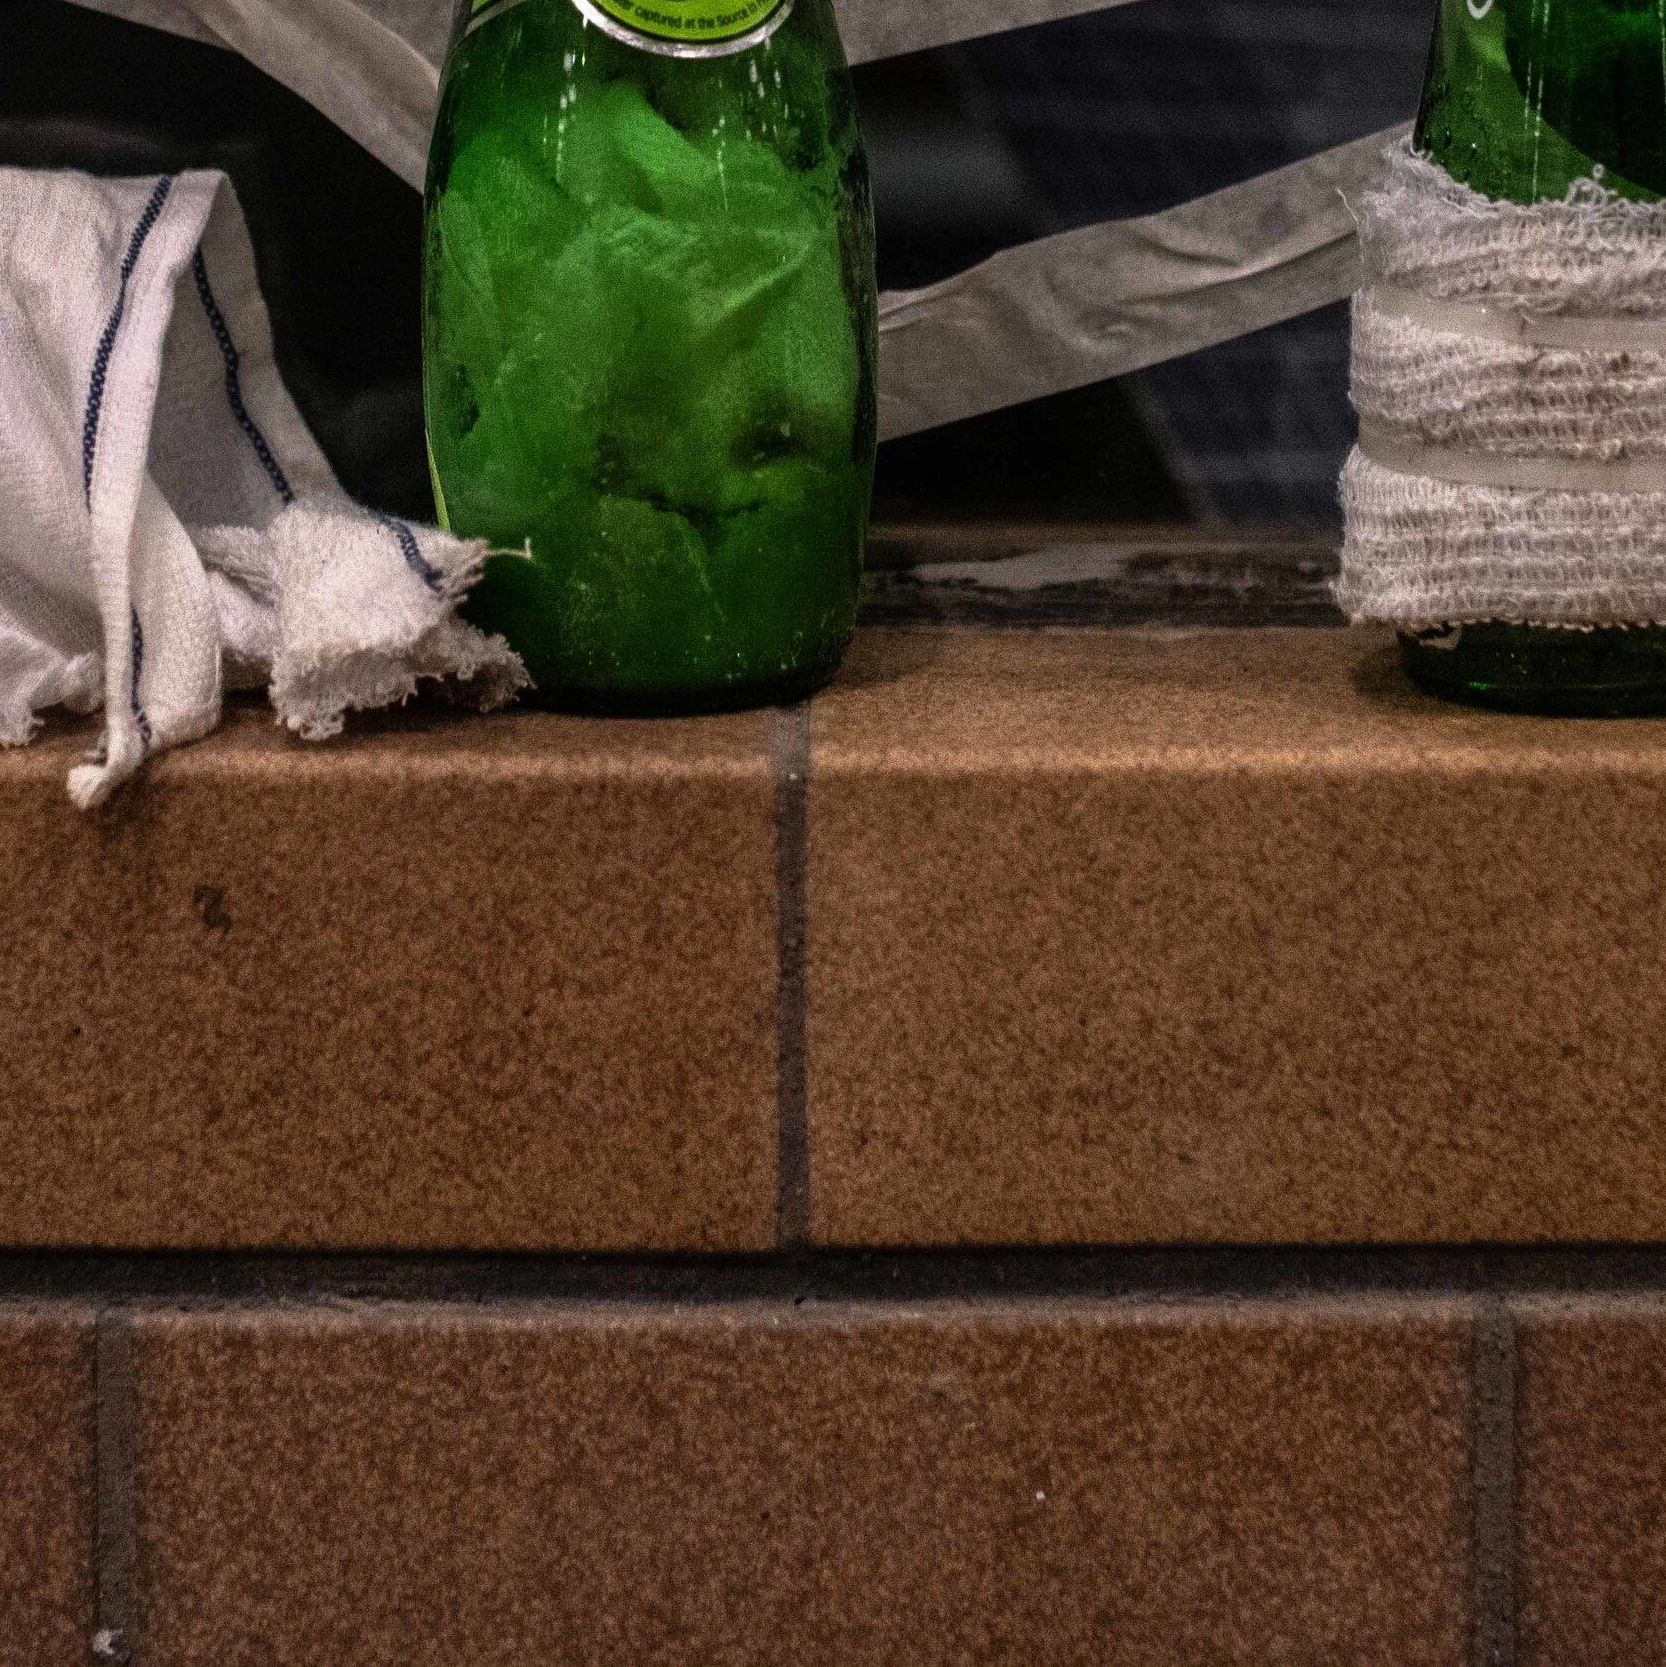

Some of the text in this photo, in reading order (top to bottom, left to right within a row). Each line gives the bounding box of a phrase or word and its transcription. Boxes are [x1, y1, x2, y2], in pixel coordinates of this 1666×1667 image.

[635, 6, 682, 29] captured
[698, 17, 715, 29] the
[717, 9, 749, 27] Source
